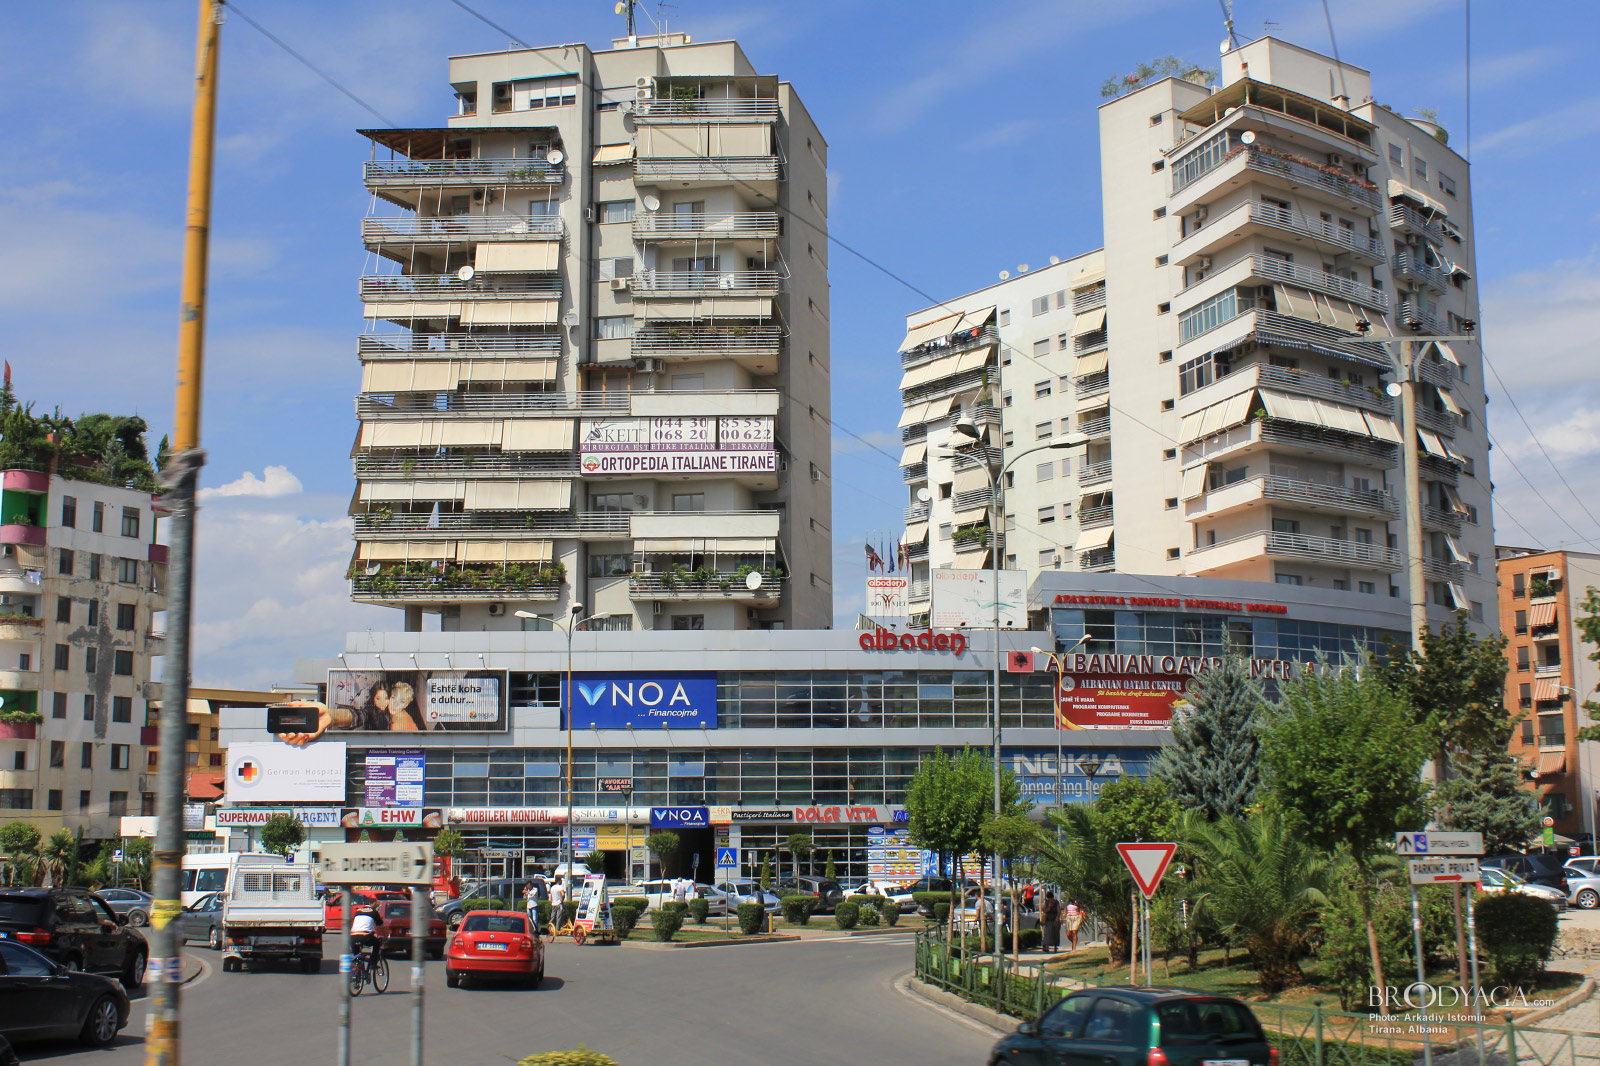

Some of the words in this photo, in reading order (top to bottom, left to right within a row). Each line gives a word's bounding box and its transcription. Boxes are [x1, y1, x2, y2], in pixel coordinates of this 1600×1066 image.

[654, 417, 684, 428] 044
[743, 417, 762, 428] 55
[654, 429, 684, 440] 068
[689, 429, 707, 440] 20
[721, 429, 739, 440] 00
[743, 429, 772, 440] 622
[601, 455, 669, 472] ORTOPEDIA
[671, 455, 727, 471] ITALIANE
[731, 452, 775, 470] TIRANË
[1045, 652, 1154, 675] ALBANIAN
[431, 682, 457, 693] Është
[458, 684, 482, 693] koha
[1080, 679, 1122, 689] ALBANIAN
[1123, 680, 1150, 690] QATAR
[1151, 680, 1182, 691] CENTER
[438, 695, 475, 704] duhur...
[612, 681, 691, 707] NOA
[648, 708, 698, 718] Financojmë
[1013, 753, 1124, 775] NOKIA
[267, 768, 300, 776] German
[305, 768, 342, 777] Hospital
[295, 811, 337, 823] ARGENT
[381, 809, 416, 823] EHW
[465, 809, 508, 823] MOBILERI
[510, 809, 551, 822] MONDIAL
[668, 809, 703, 821] NOA
[845, 807, 878, 821] VITA
[1412, 863, 1446, 875] PARKING
[1448, 862, 1475, 874] PRIVAT
